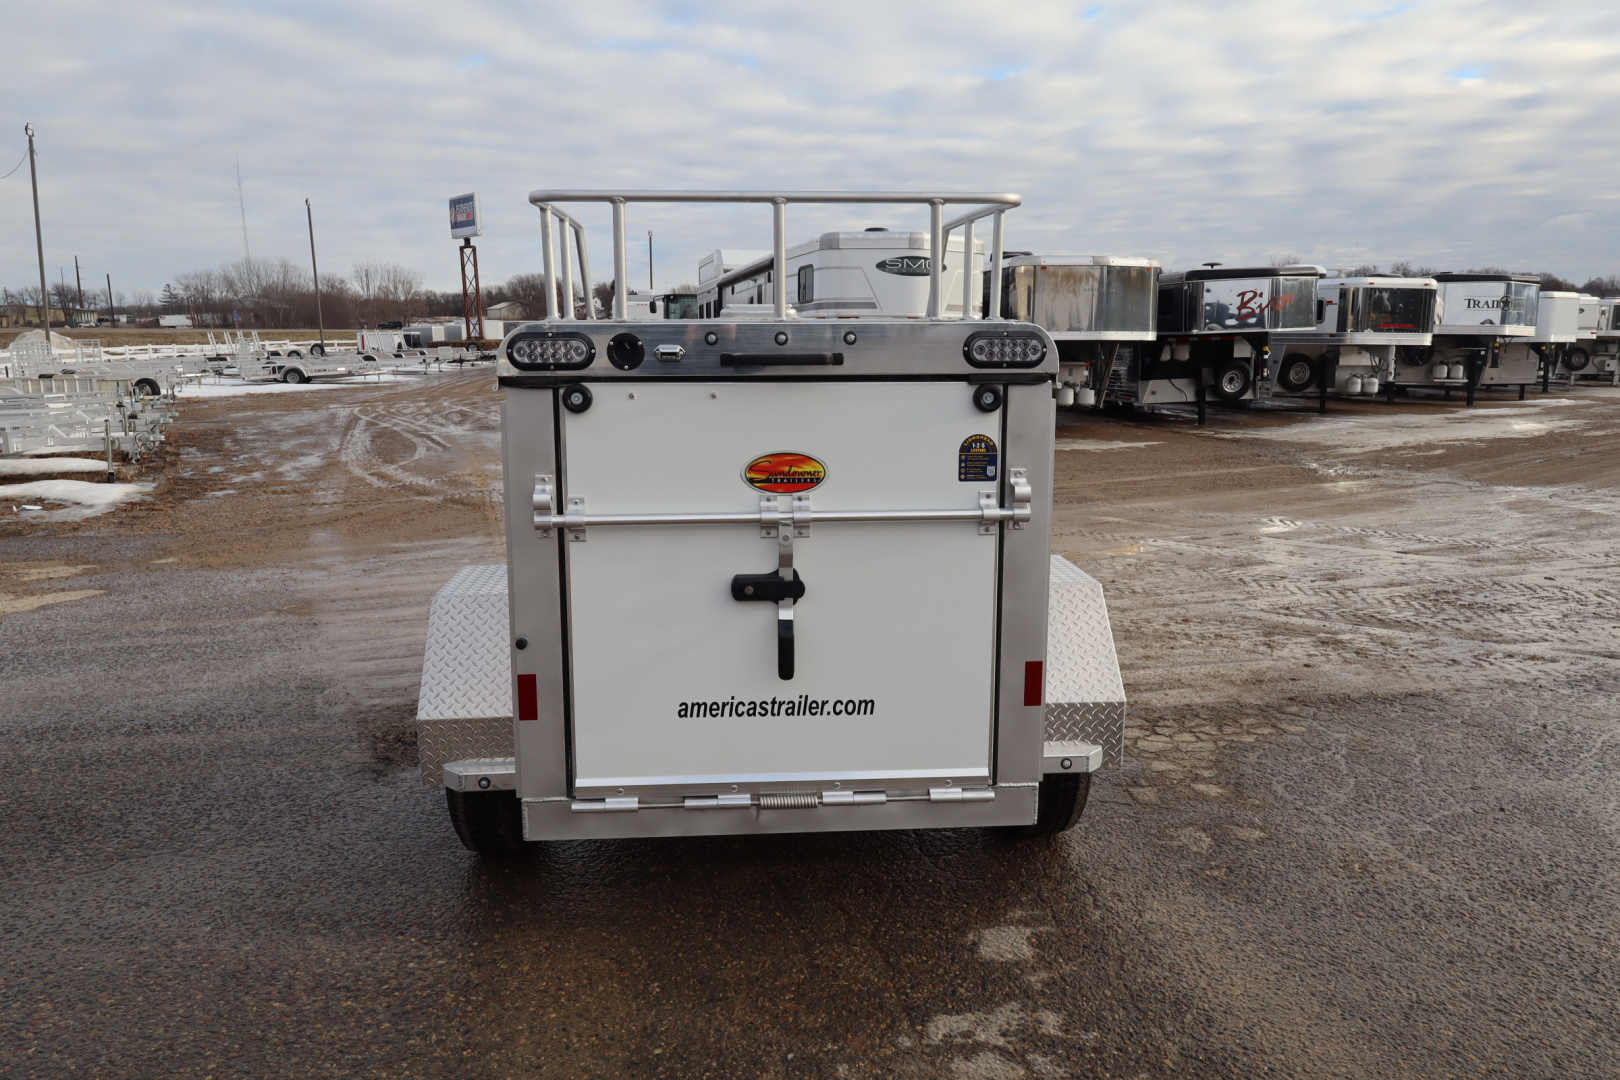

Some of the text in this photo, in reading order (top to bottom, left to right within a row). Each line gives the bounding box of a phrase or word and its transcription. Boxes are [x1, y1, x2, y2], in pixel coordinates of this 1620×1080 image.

[1235, 290, 1295, 322] Bison
[963, 435, 994, 446] LIONSHEAD
[749, 460, 822, 481] Sundowner
[677, 694, 875, 718] americastrailer.com
